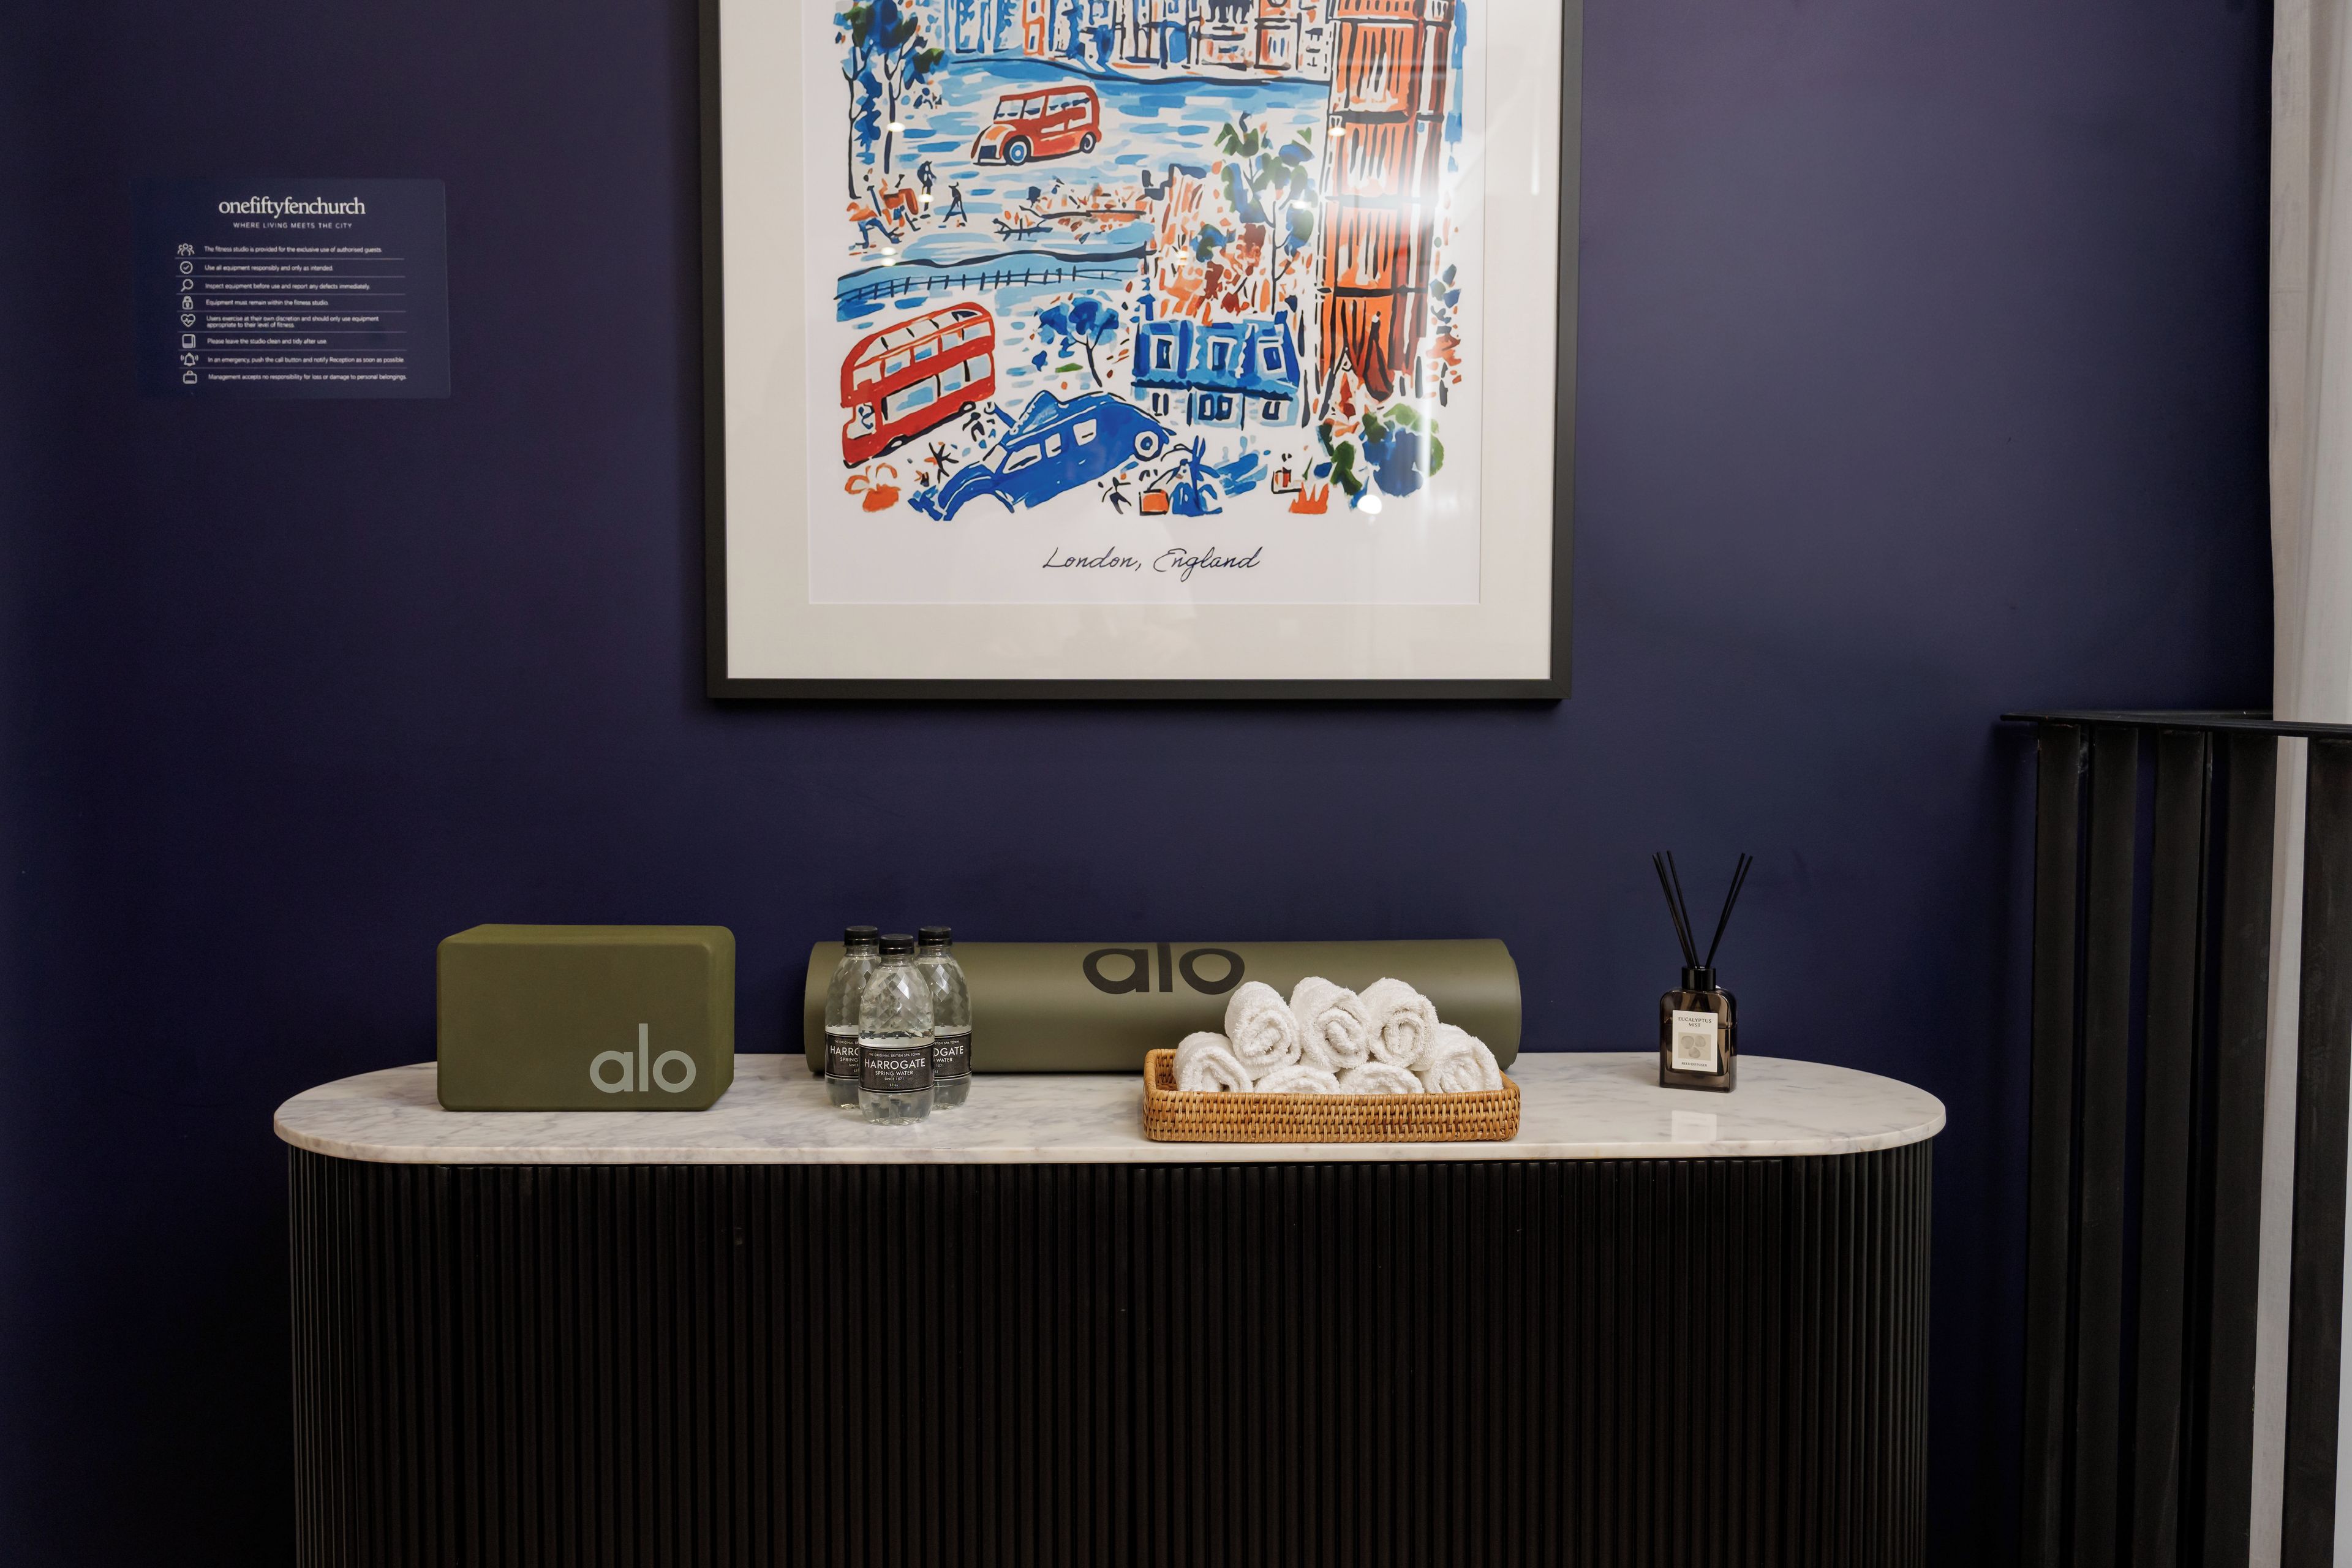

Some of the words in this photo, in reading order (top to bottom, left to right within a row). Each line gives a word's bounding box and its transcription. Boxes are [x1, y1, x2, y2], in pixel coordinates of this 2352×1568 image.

[219, 196, 366, 219] onefiftyfenchurch
[1043, 546, 1141, 571] London,
[1153, 546, 1263, 582] England
[1083, 942, 1245, 995] alo
[590, 1023, 696, 1093] alo
[864, 1058, 925, 1069] HARROGATE
[935, 1046, 963, 1057] OGATE
